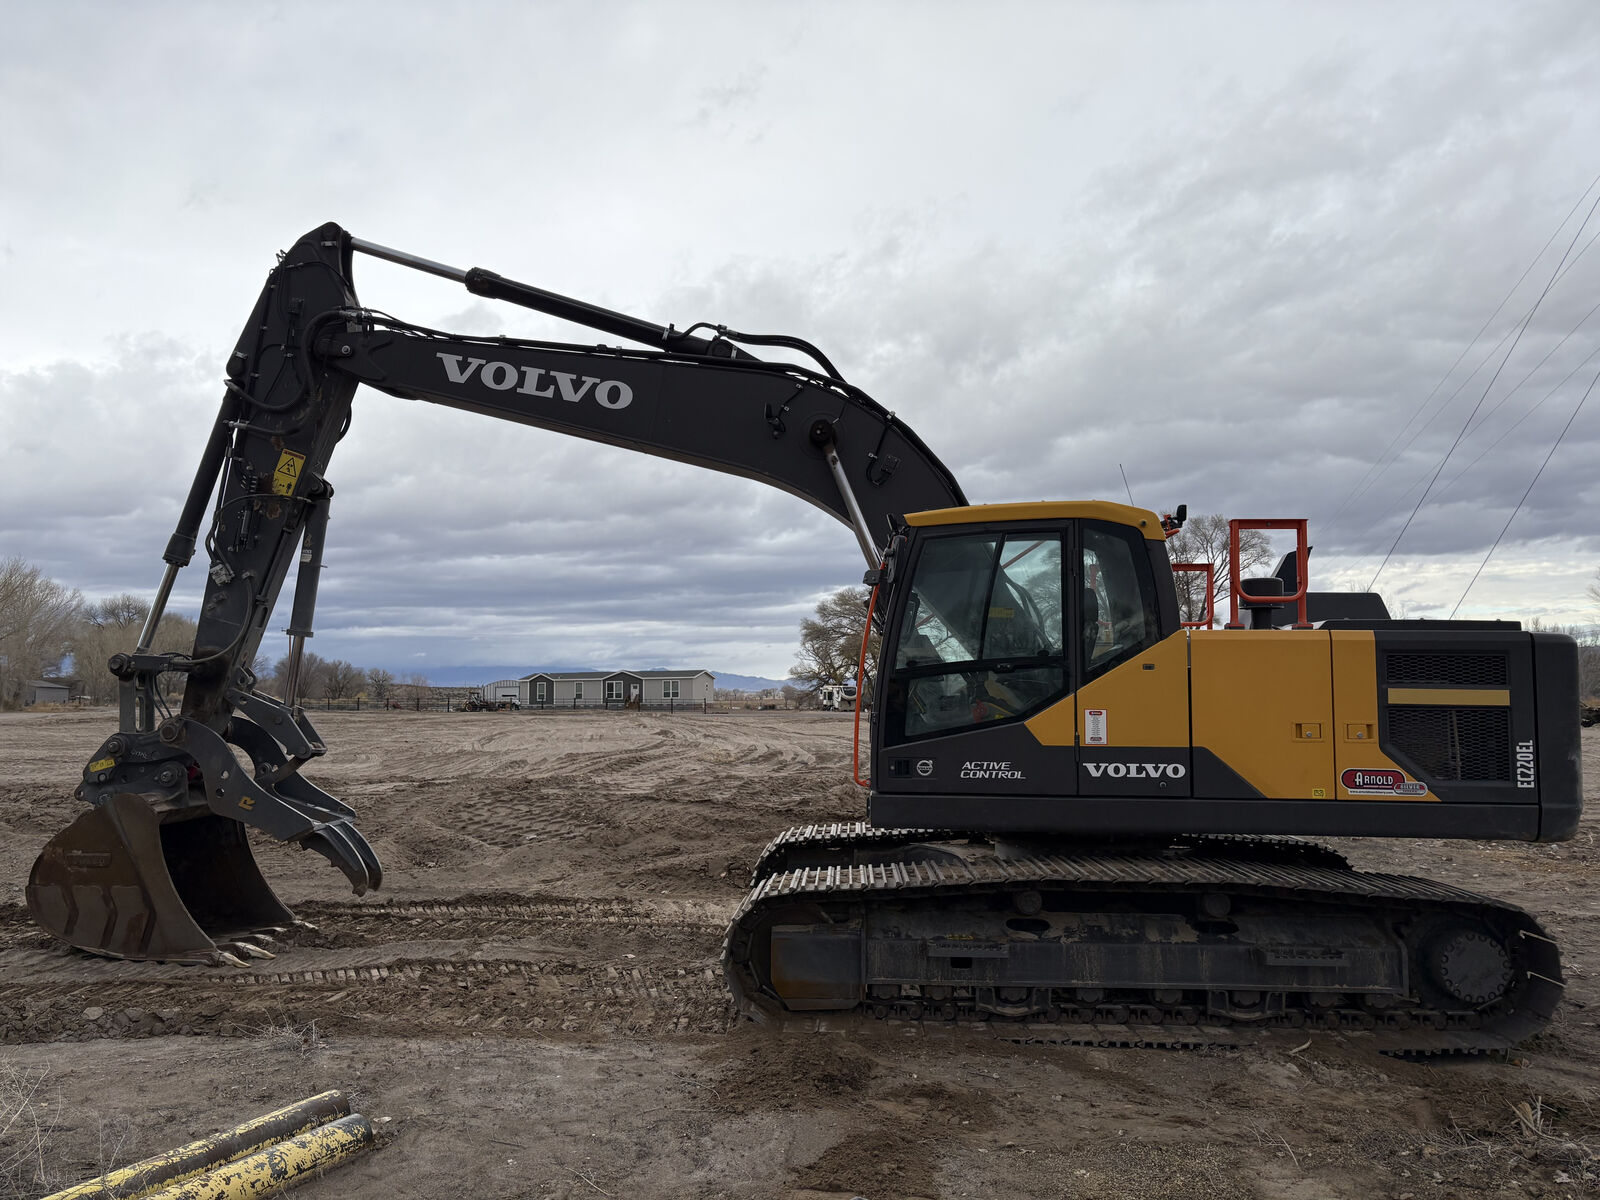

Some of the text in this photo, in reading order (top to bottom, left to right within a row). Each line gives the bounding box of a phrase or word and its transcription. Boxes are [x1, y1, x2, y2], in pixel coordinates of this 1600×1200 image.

[436, 352, 634, 410] VOLVO
[961, 761, 1010, 770] ACTIVE
[1083, 763, 1186, 778] VOLVO
[1516, 739, 1535, 788] EC220EL
[960, 771, 1026, 780] CONTROL
